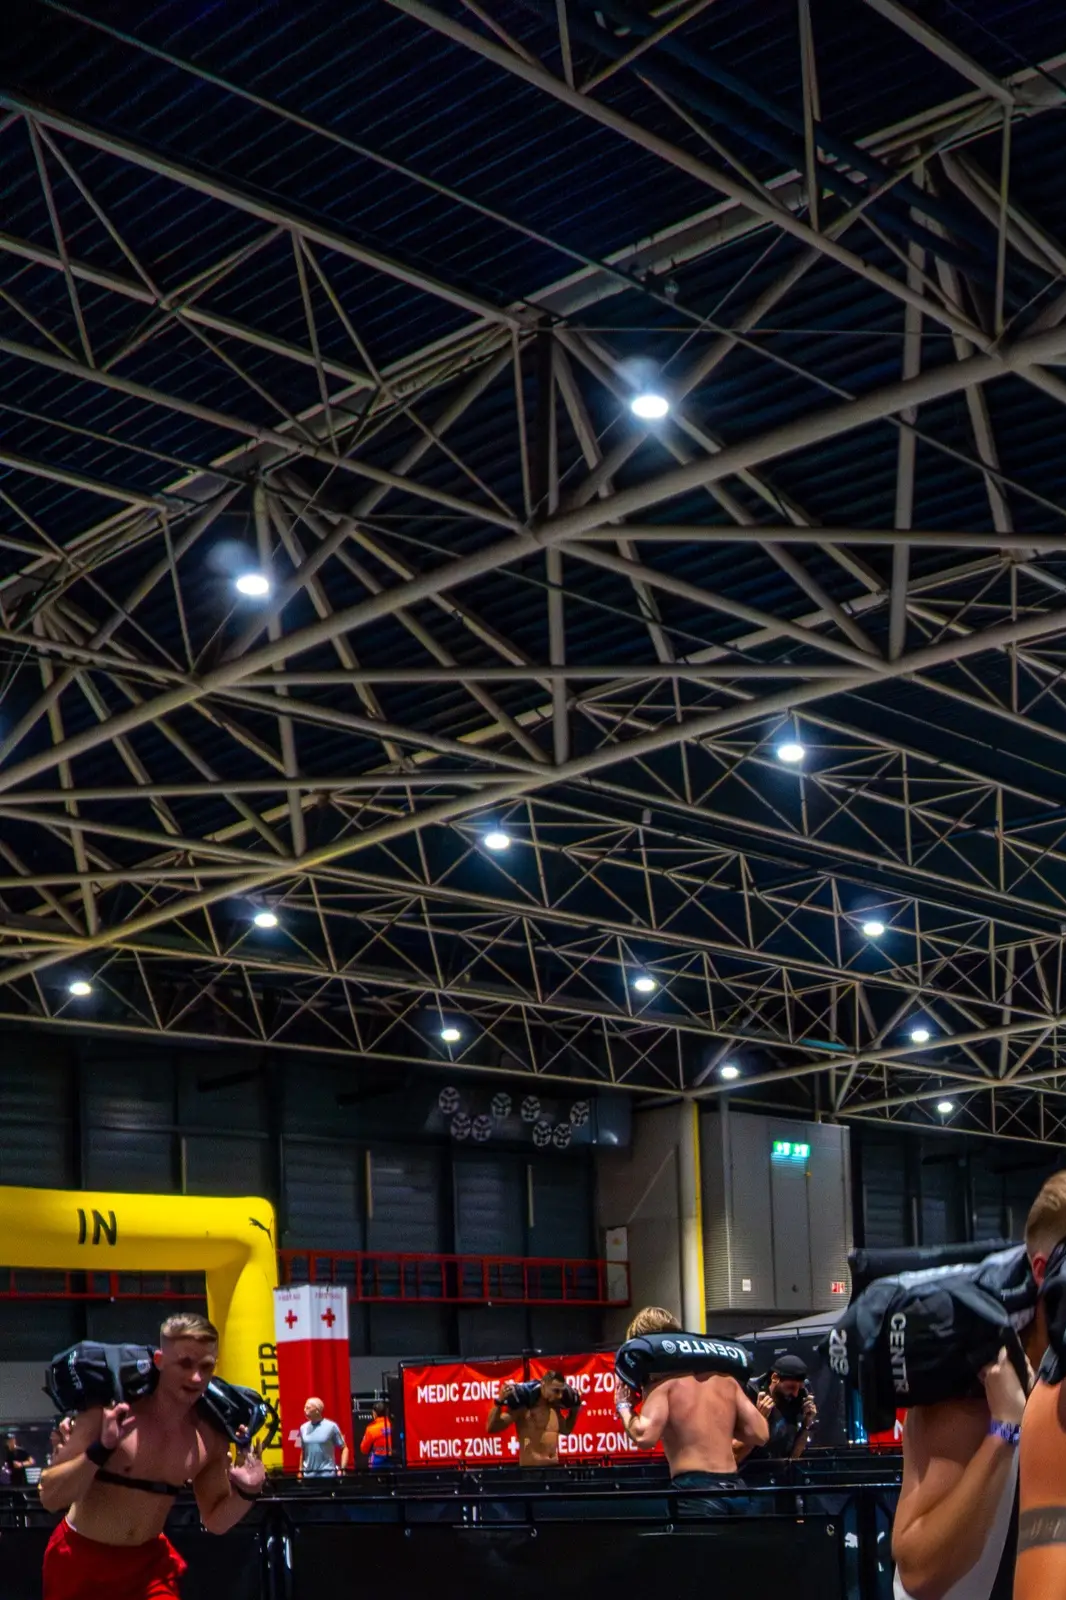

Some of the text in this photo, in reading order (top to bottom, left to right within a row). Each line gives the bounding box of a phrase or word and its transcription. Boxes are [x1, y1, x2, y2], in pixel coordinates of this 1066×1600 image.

[77, 1208, 117, 1246] IN
[677, 1340, 740, 1359] CENTR
[890, 1312, 910, 1393] CENTR
[417, 1380, 500, 1403] MEDIC ZONE
[420, 1437, 502, 1458] MEDIC ZONE
[557, 1434, 593, 1453] EDIC
